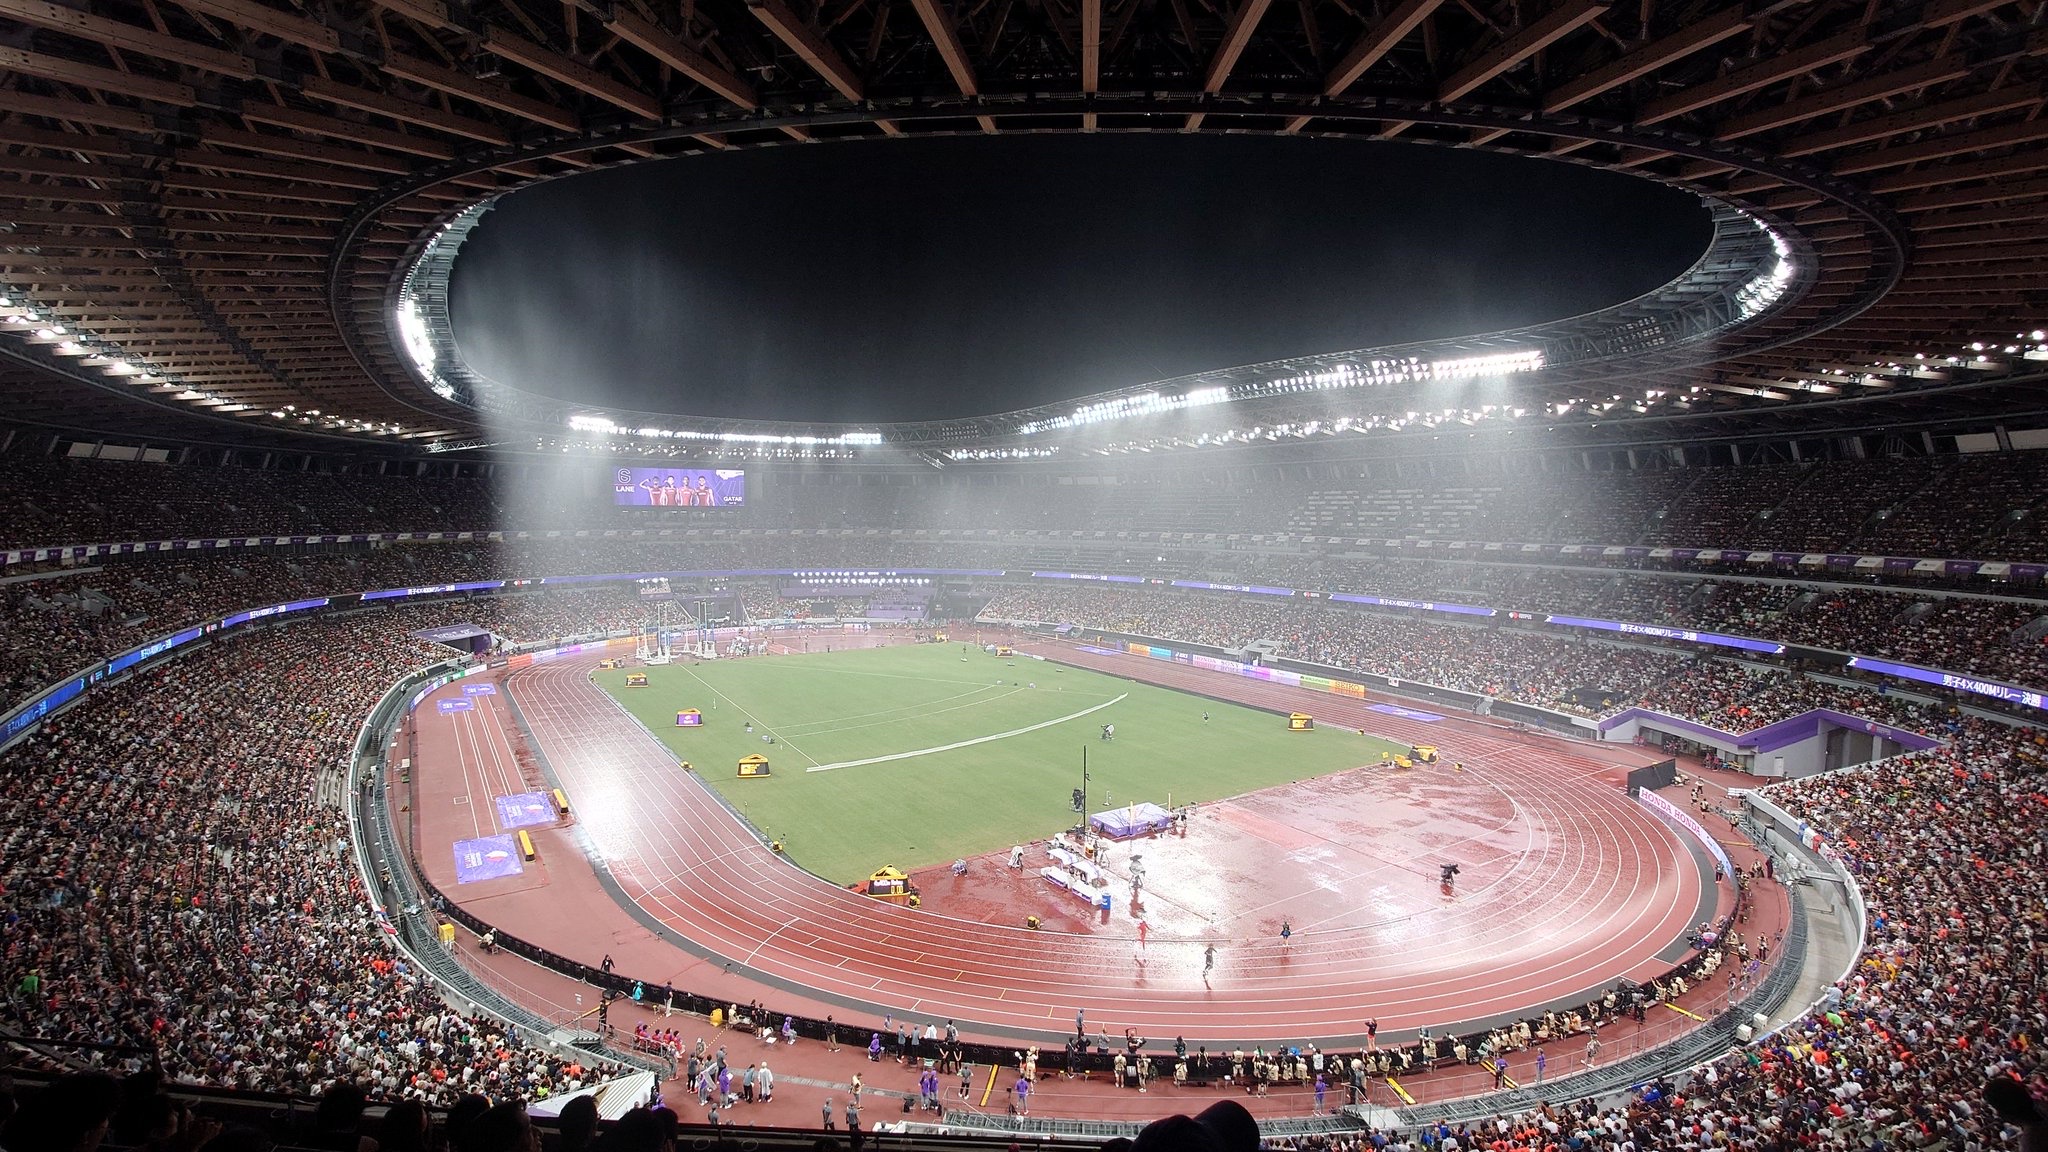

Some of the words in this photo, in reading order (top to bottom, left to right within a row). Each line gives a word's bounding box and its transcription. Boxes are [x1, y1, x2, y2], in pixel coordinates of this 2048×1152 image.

[1335, 681, 1360, 691] SEIKO
[1641, 790, 1672, 813] HONDA
[1674, 810, 1700, 835] HONDA
